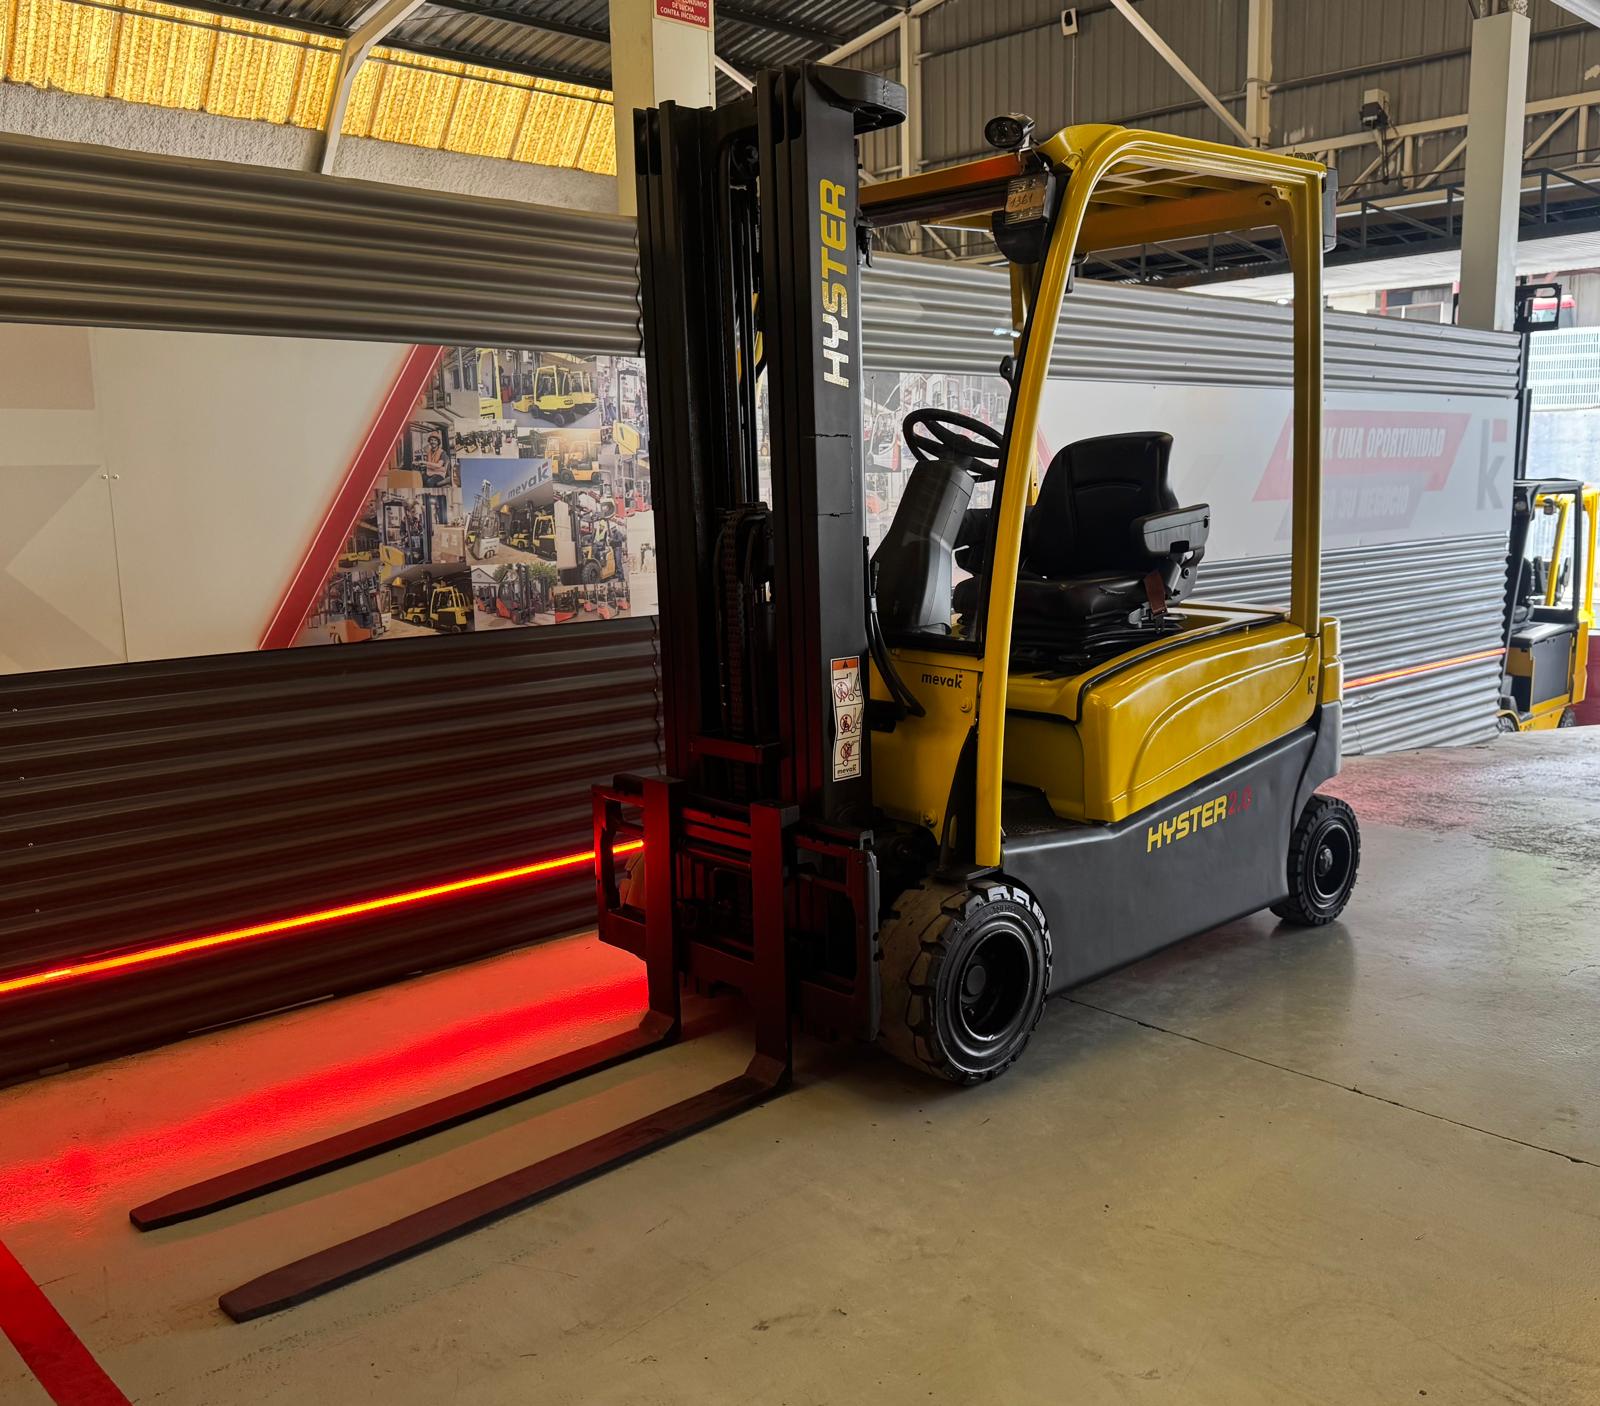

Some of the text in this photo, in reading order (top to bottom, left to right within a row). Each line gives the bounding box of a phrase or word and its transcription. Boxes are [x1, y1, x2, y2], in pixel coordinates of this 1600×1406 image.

[660, 6, 680, 16] CONTRA
[819, 178, 850, 388] HYSTER
[1337, 427, 1365, 459] UNA
[1366, 427, 1446, 459] OPORTUNIDAD
[507, 461, 549, 500] mevak
[921, 672, 963, 689] mevak
[837, 764, 857, 774] mevak
[1147, 795, 1227, 853] HYSTER
